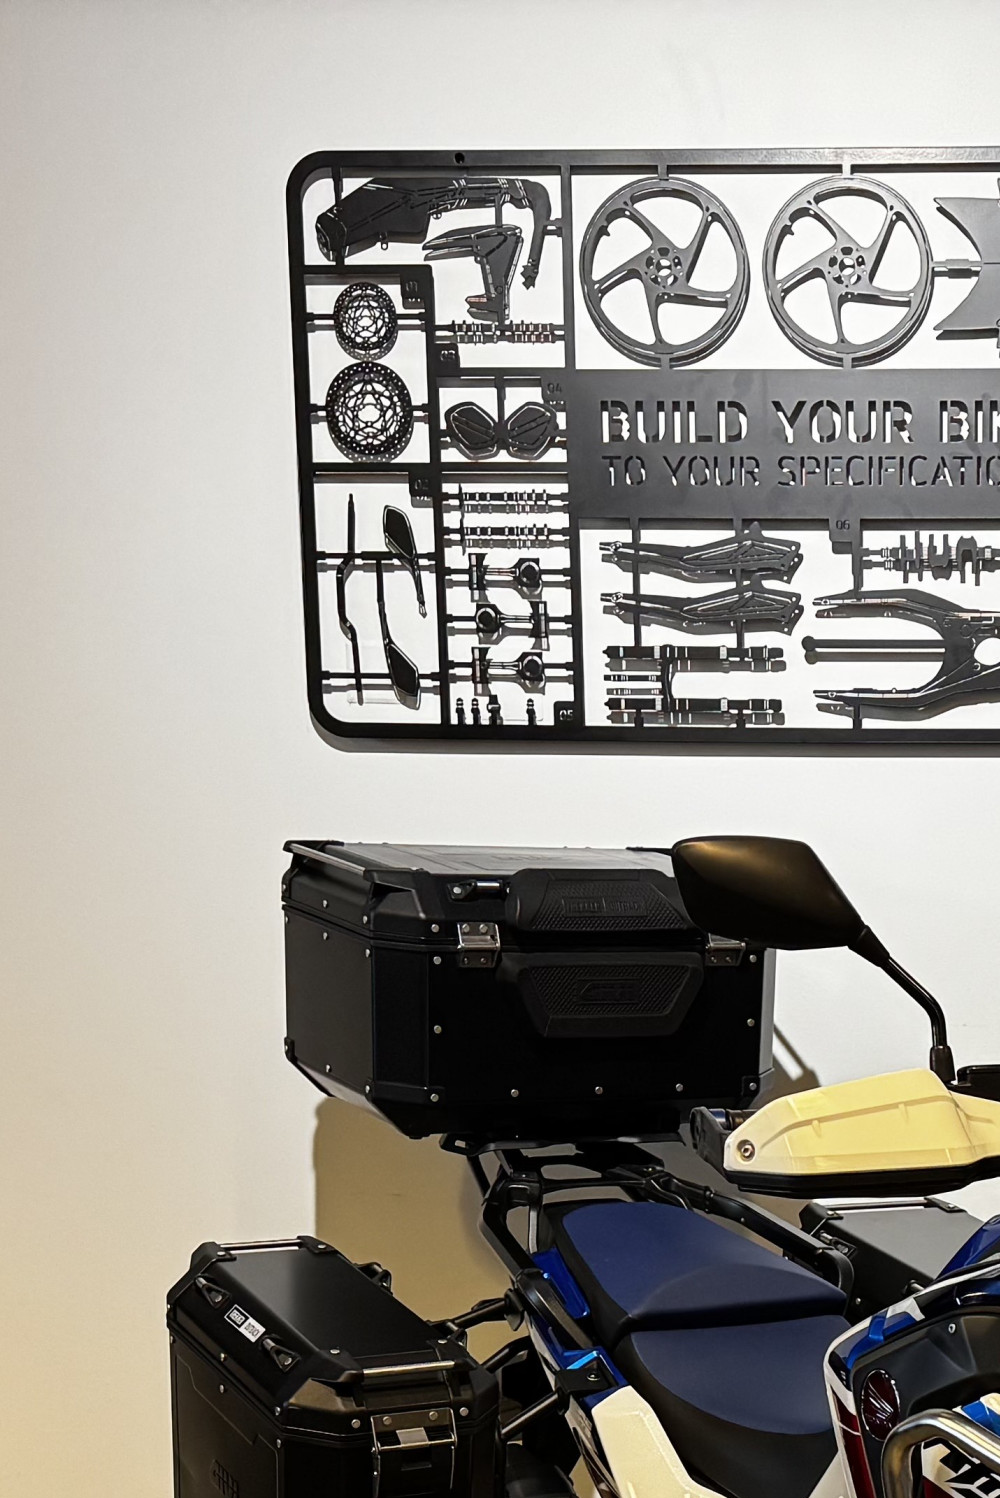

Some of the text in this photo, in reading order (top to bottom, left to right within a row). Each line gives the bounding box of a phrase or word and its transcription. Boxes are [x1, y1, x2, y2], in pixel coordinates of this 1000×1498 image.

[600, 400, 748, 443] BUILD
[771, 400, 915, 443] YOUR
[601, 455, 647, 486] TO
[662, 455, 760, 486] YOUR
[835, 519, 851, 530] 06
[559, 709, 574, 721] 05
